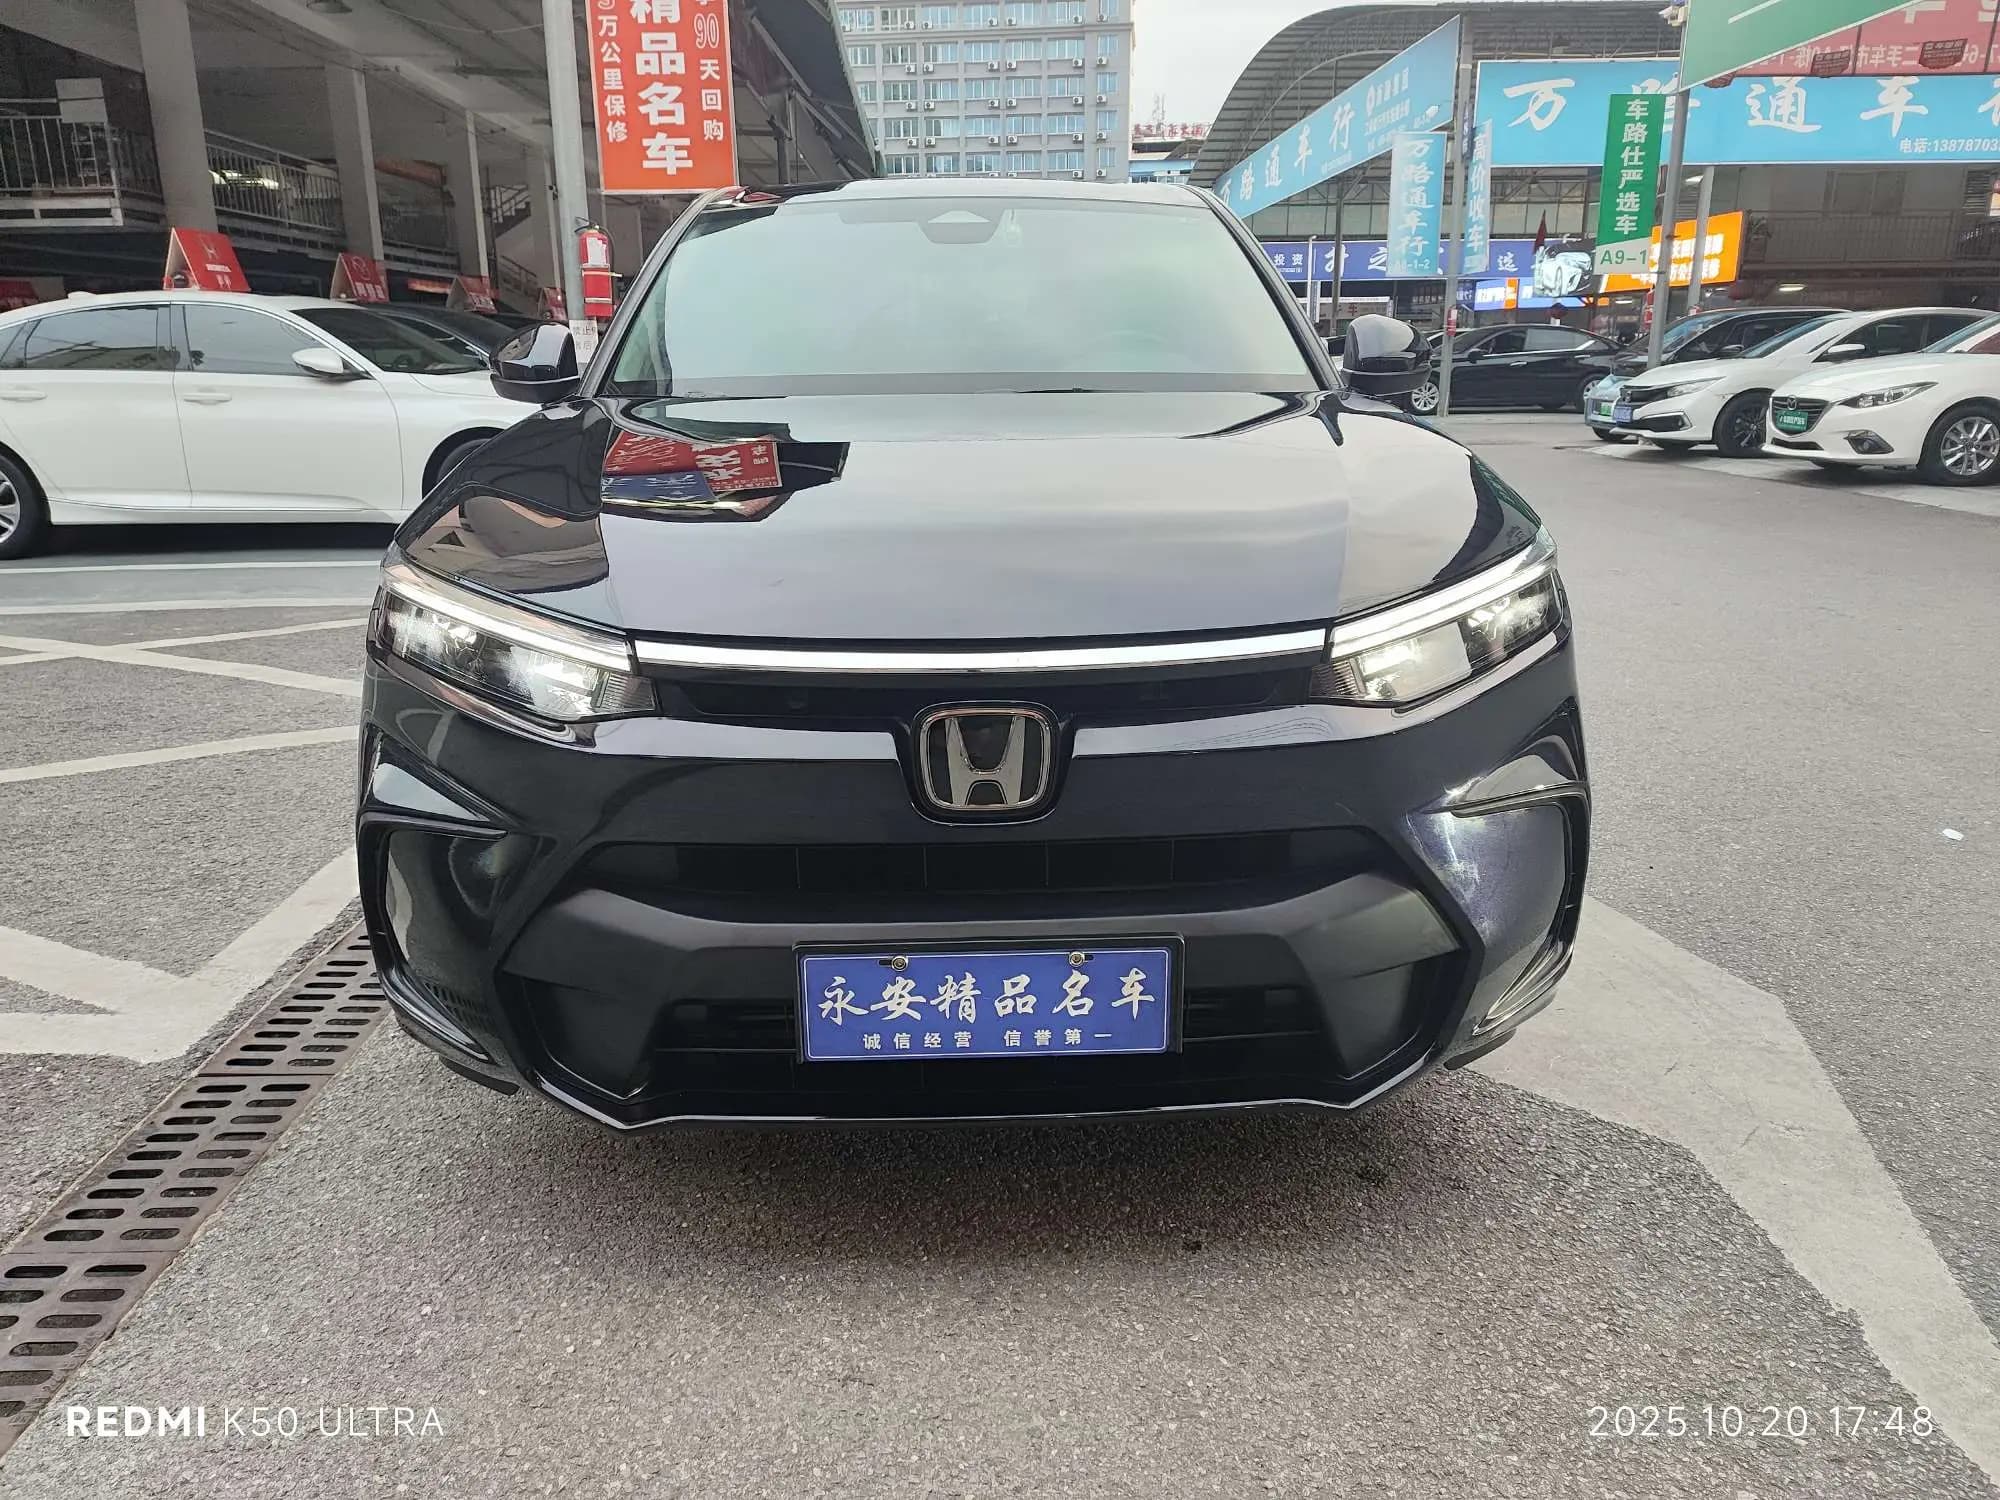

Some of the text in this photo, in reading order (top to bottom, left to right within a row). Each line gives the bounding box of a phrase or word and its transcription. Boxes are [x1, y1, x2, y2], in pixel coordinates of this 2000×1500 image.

[1899, 137, 2000, 154] 电话:13878703
[1613, 98, 1650, 235] 车路仕严选车
[1600, 249, 1648, 265] A9-1
[818, 967, 1155, 1026] 永安精品名车
[862, 1028, 1112, 1051] 诚信经营 信誉第一
